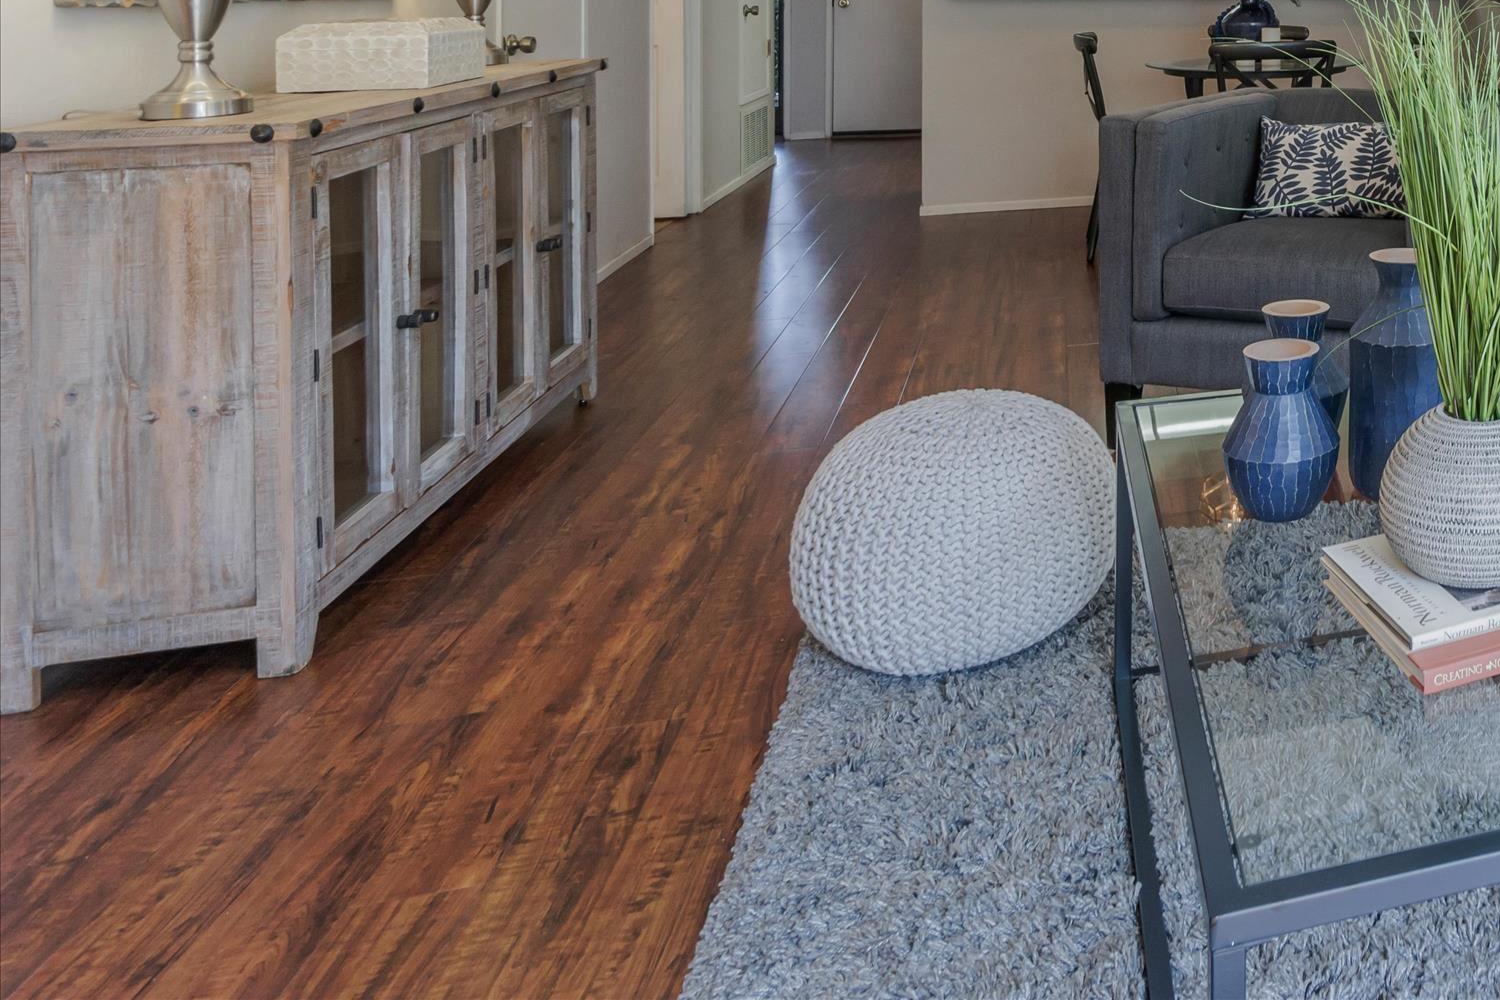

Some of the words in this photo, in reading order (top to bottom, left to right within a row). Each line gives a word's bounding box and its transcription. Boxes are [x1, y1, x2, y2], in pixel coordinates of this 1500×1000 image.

[1342, 544, 1394, 585] Rockwell
[1387, 582, 1437, 626] Norman
[1444, 624, 1484, 641] Norman
[1433, 663, 1483, 686] CREATING
